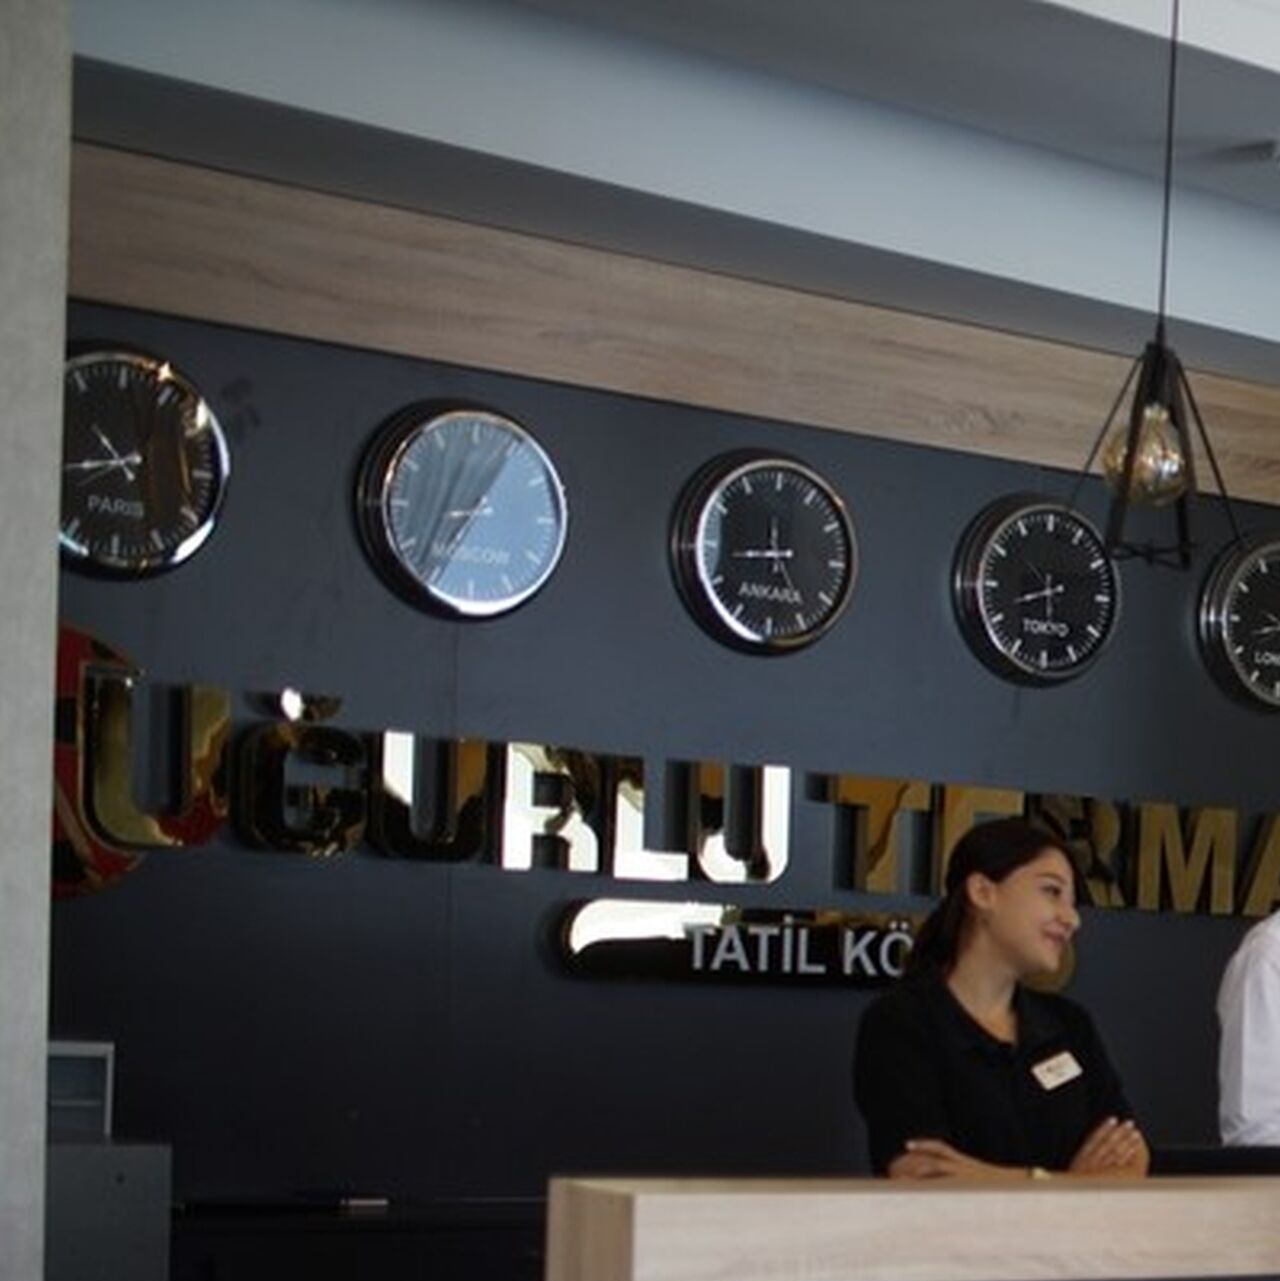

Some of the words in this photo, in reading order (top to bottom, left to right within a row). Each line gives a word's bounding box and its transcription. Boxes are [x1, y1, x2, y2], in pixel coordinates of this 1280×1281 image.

[87, 494, 144, 519] PARIS
[738, 581, 803, 606] ANKARA
[1023, 617, 1069, 638] TOKYO
[685, 915, 827, 975] TATİL
